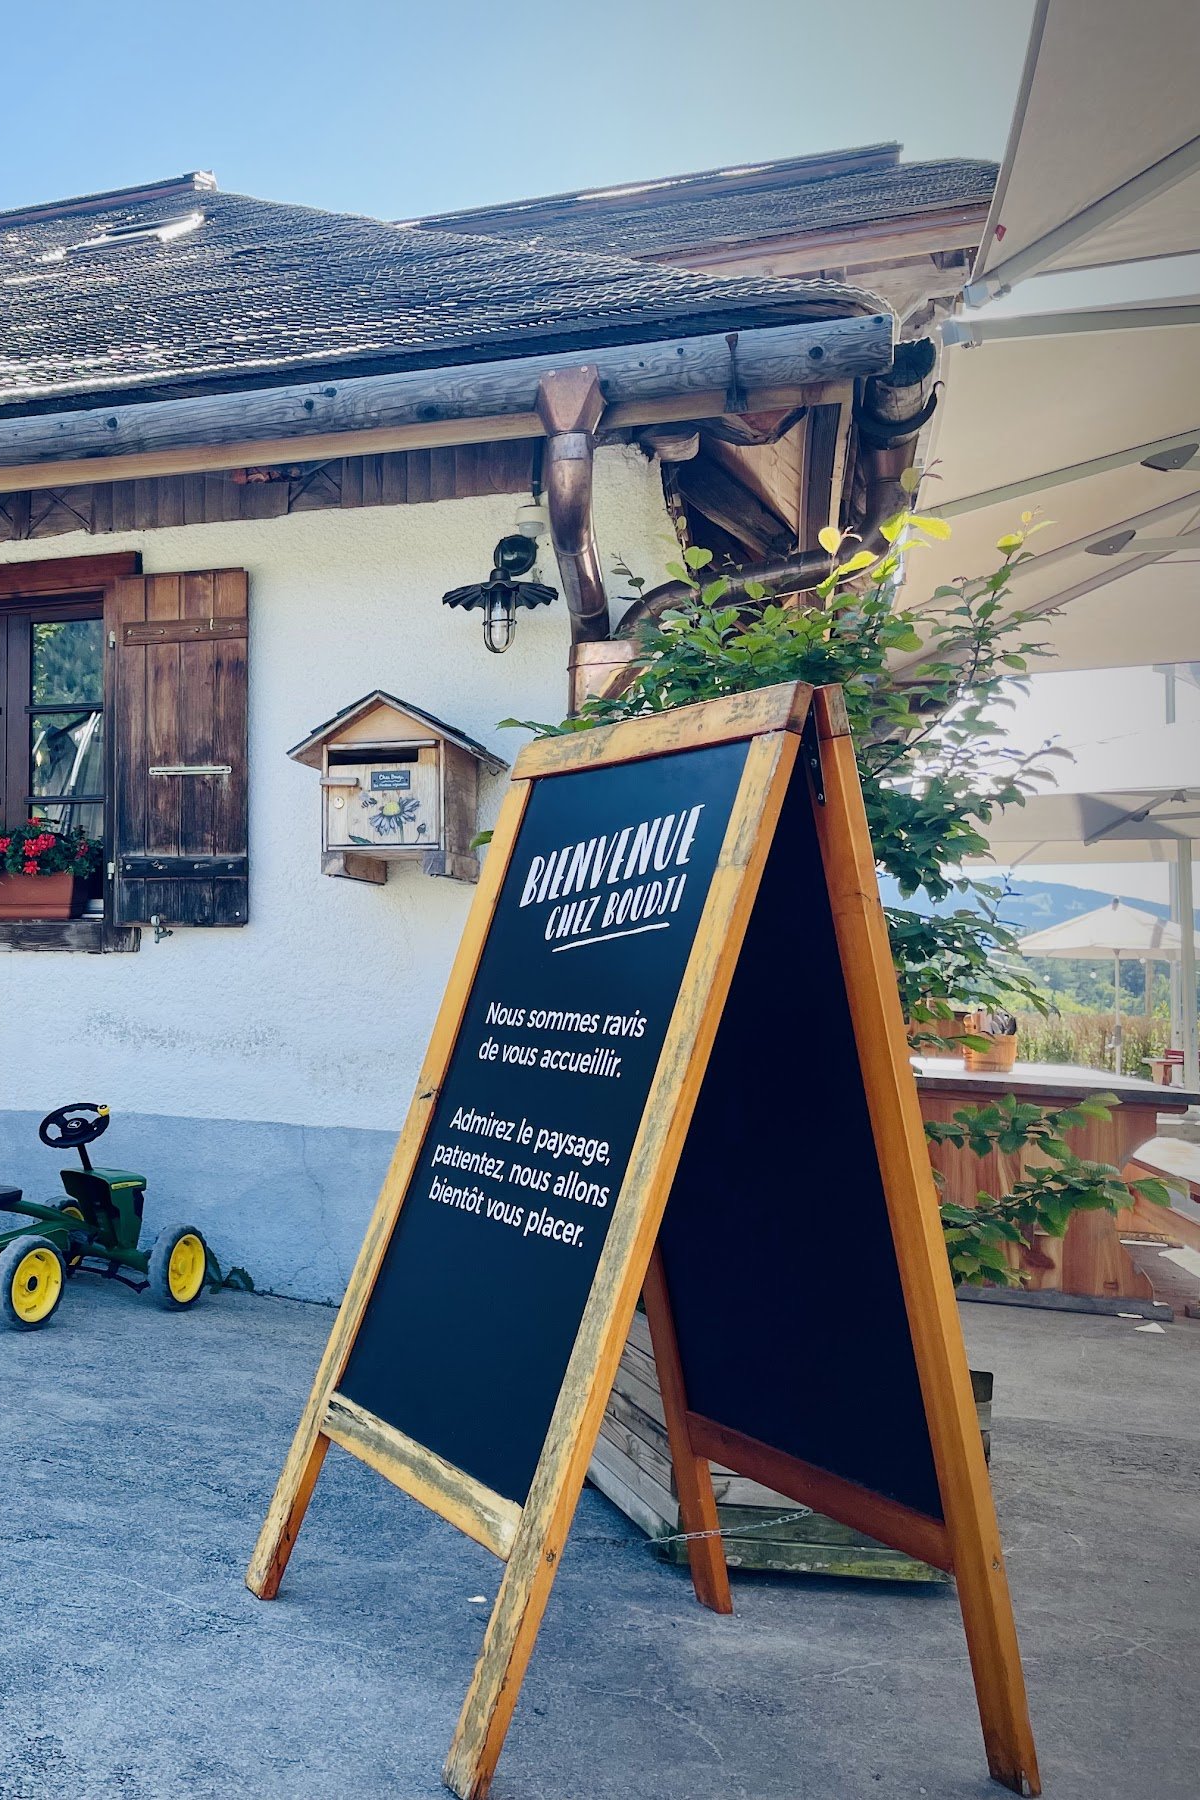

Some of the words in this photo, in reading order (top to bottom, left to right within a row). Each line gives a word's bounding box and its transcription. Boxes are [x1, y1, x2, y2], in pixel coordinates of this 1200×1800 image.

[519, 804, 705, 908] BIENVENUE
[544, 895, 602, 941] CHEZ
[601, 874, 687, 929] BOUDJI
[485, 1001, 527, 1028] Nous
[526, 1009, 601, 1034] sommes
[601, 1009, 648, 1038] ravis
[478, 1036, 499, 1061] de
[502, 1044, 539, 1067] vous
[539, 1047, 622, 1078] accueillir.
[449, 1106, 516, 1142] Admirez
[516, 1117, 534, 1145] le
[533, 1128, 611, 1167] paysage,
[430, 1144, 505, 1183] patientez,
[508, 1163, 552, 1192] nous
[552, 1170, 611, 1208] allons
[428, 1175, 485, 1215] bientôt
[486, 1198, 525, 1227] vous
[523, 1207, 584, 1248] placer.
